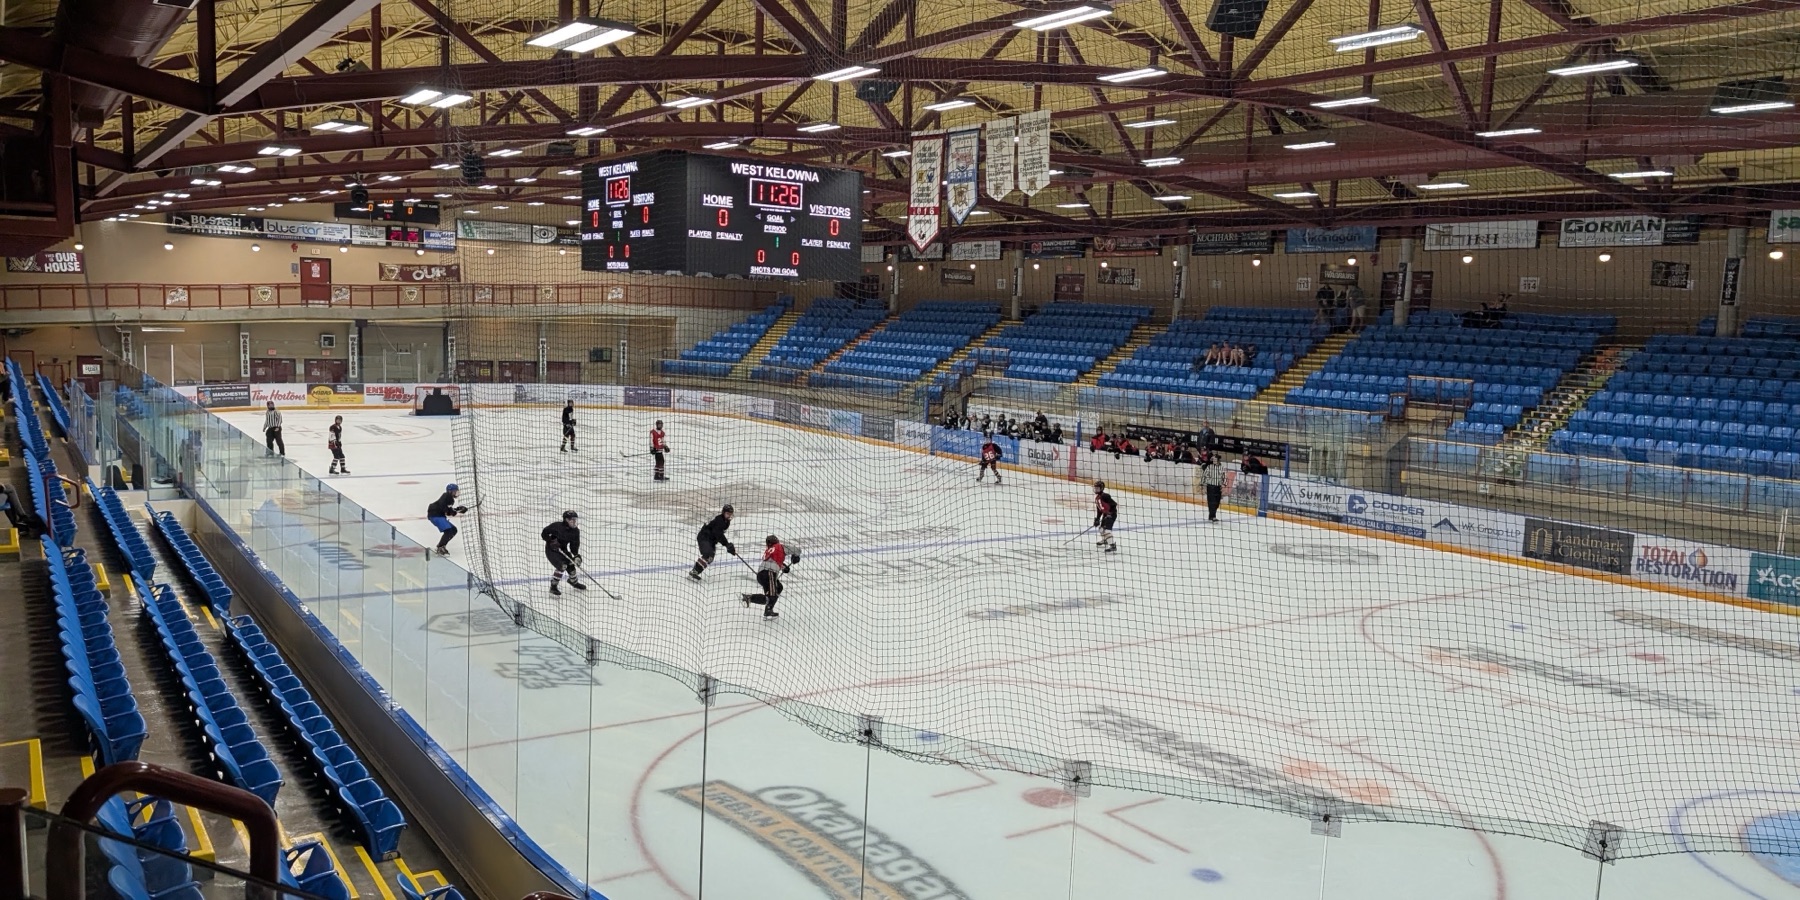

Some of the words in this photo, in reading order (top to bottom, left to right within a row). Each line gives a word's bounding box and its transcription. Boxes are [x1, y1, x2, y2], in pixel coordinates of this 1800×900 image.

[731, 162, 763, 176] WEST
[765, 166, 819, 183] KELOWNA
[703, 194, 733, 206] HOME
[759, 184, 799, 206] 11:26
[643, 206, 649, 223] 0
[718, 209, 728, 227] 0
[810, 204, 851, 217] VISITORS
[593, 211, 599, 228] 0
[1564, 219, 1662, 233] GORMAN
[266, 222, 321, 236] bluestar
[688, 230, 712, 238] PLAYER
[716, 231, 743, 240] PENALTY
[764, 224, 787, 232] PERIOD
[830, 219, 839, 236] 0
[826, 240, 850, 249] PENALTY
[55, 252, 77, 262] OUR
[757, 250, 765, 263] 0
[792, 252, 799, 265] 0
[44, 261, 81, 272] HOUSE
[750, 266, 770, 274] SHOTS
[782, 268, 798, 276] GOAL
[241, 334, 249, 376] WARRIORS
[349, 336, 357, 376] WARRIORS
[252, 390, 268, 401] Tim
[269, 389, 306, 401] Hortons
[984, 451, 995, 460] 26
[1028, 448, 1053, 461] Global
[1299, 487, 1342, 504] SUMMIT
[1372, 500, 1425, 516] COOPER
[1477, 523, 1504, 538] Group
[1556, 530, 1624, 553] Landmark
[1558, 545, 1620, 566] Clothiers
[1642, 545, 1686, 566] TOTAL
[1635, 557, 1738, 588] RESTORATION
